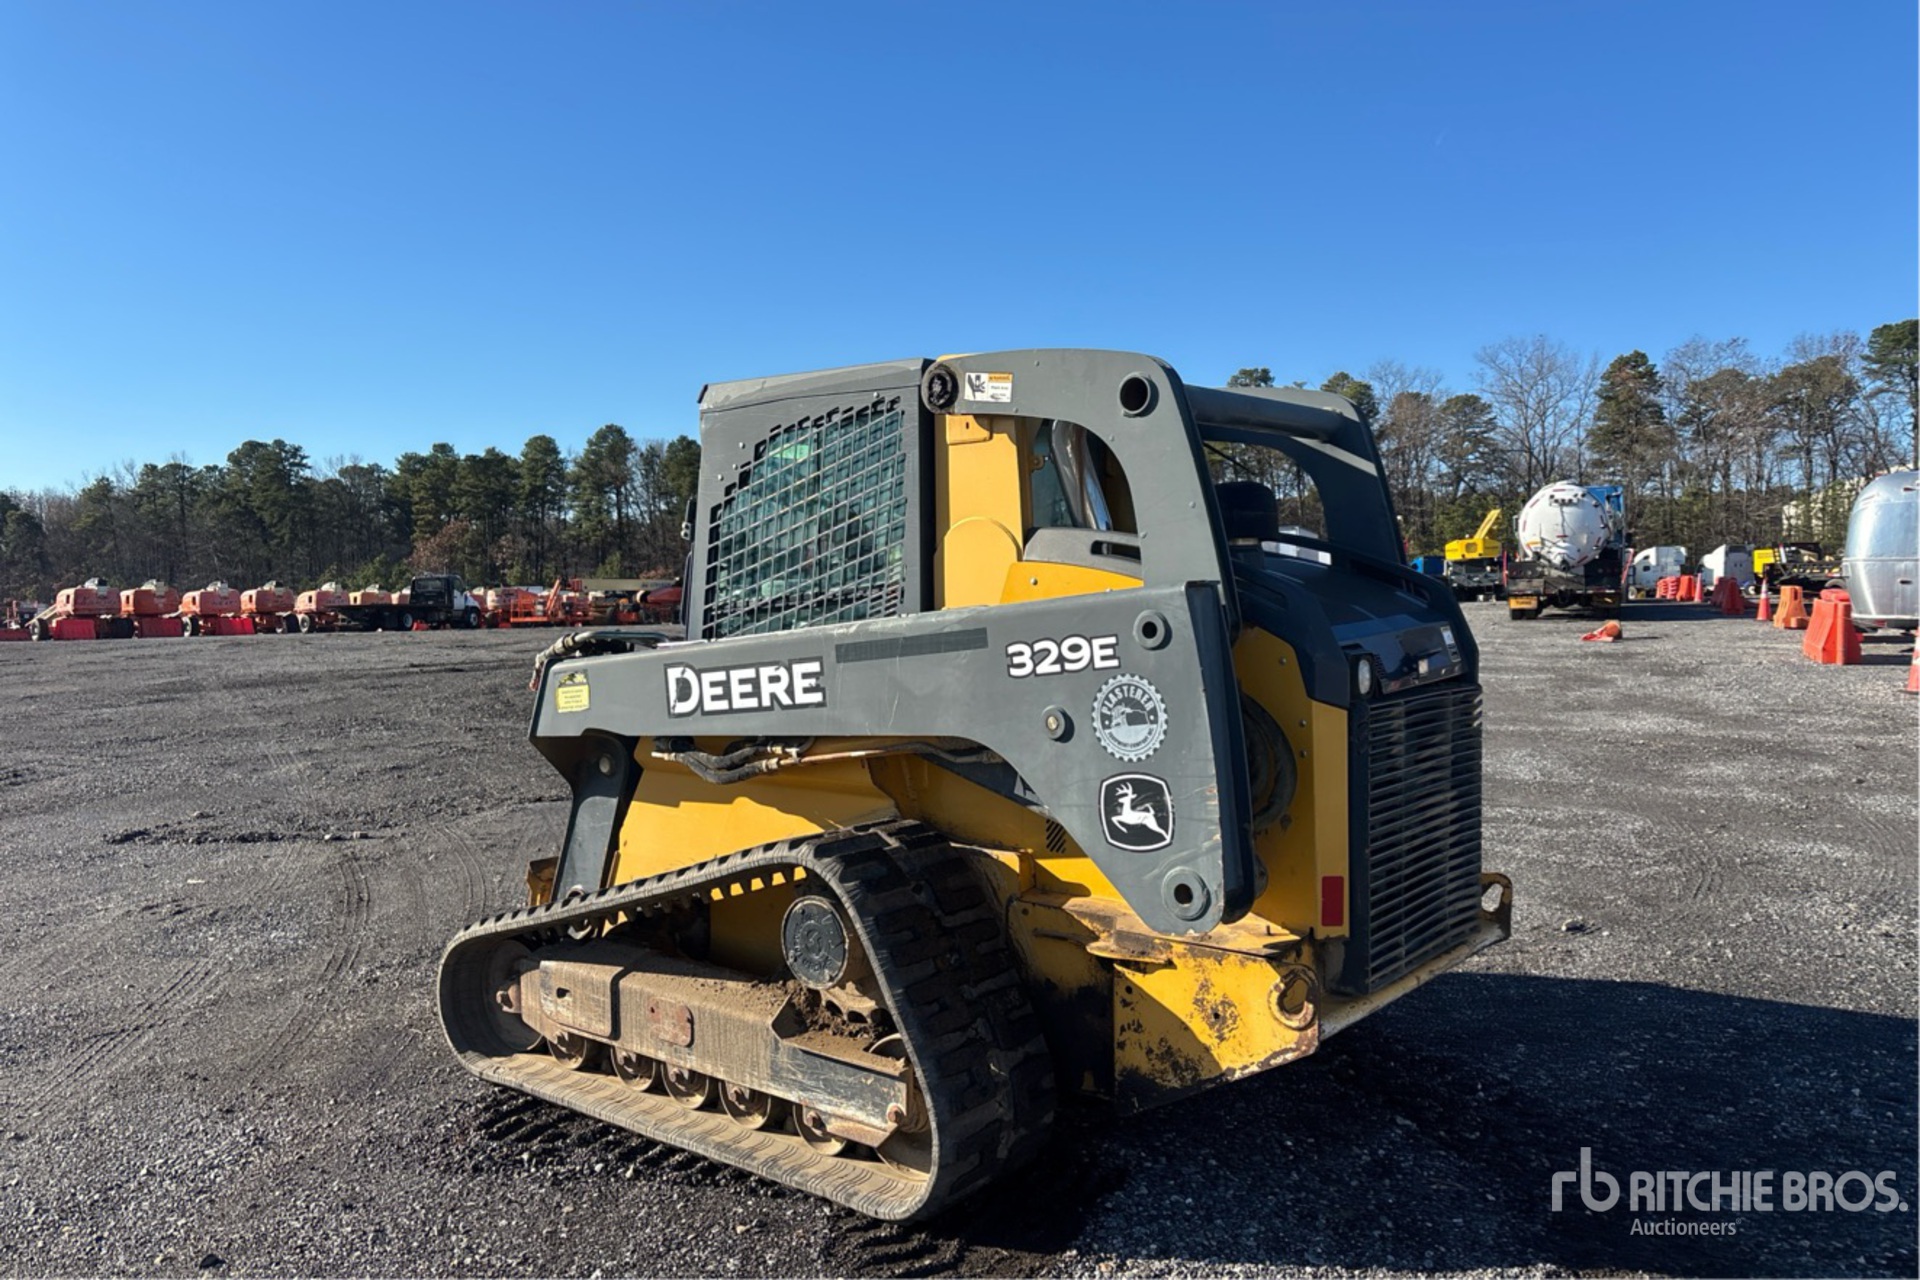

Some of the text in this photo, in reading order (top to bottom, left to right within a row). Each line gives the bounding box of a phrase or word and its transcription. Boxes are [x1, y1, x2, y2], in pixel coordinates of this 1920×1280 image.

[1006, 636, 1120, 677] 329E
[666, 661, 824, 715] DEERE
[1101, 685, 1155, 715] PLASTERER
